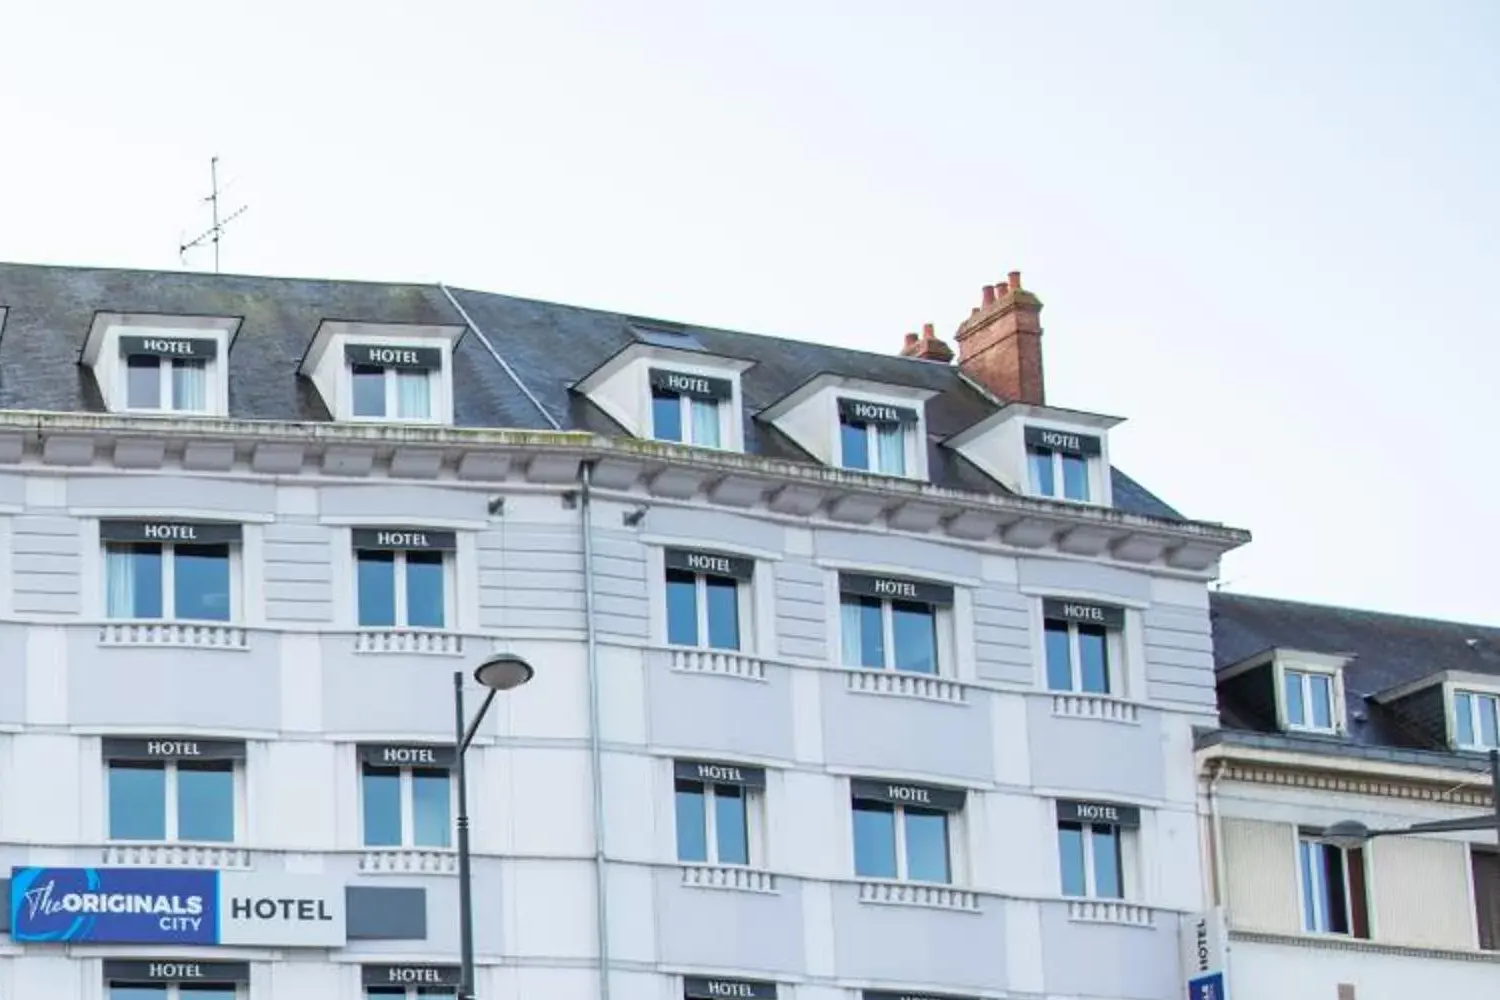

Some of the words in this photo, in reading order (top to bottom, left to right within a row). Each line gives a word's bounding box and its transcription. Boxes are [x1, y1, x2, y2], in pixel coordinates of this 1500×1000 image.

[144, 339, 194, 354] HOTEL
[369, 349, 419, 363] HOTEL
[669, 375, 711, 393] HOTEL
[856, 404, 900, 420] HOTEL
[1043, 432, 1080, 448] HOTEL
[145, 525, 196, 539] HOTEL
[378, 532, 429, 546] HOTEL
[688, 555, 730, 573] HOTEL
[875, 580, 917, 597] HOTEL
[1064, 604, 1104, 620] HOTEL
[148, 742, 201, 755] HOTEL
[384, 748, 435, 762] HOTEL
[698, 765, 744, 780] HOTEL
[889, 786, 930, 802] HOTEL
[1077, 805, 1118, 820] HOTEL
[25, 880, 63, 920] The
[62, 893, 203, 914] ORIGINALS
[231, 897, 333, 921] HOTEL
[159, 917, 202, 932] CITY
[1196, 919, 1209, 971] HOTEL
[149, 963, 203, 977] HOTEL
[389, 968, 441, 982] HOTEL
[708, 981, 754, 996] HOTEL
